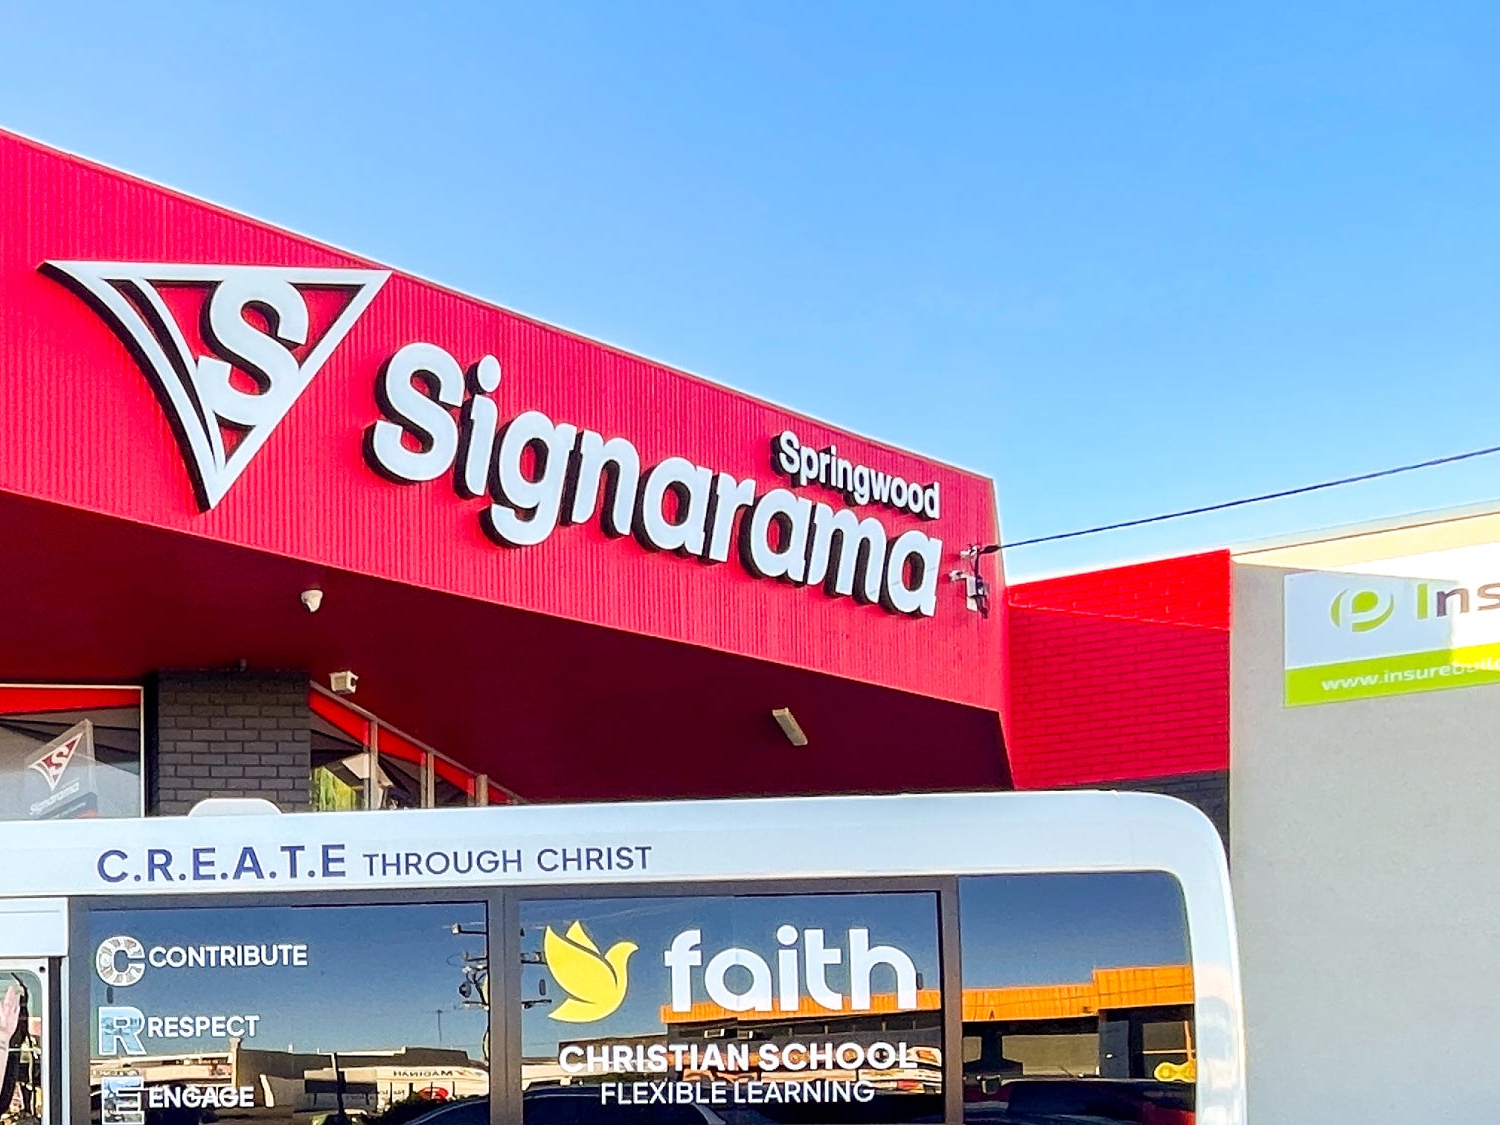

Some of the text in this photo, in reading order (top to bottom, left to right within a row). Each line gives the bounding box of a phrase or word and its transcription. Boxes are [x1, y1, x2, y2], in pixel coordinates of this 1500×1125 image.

[370, 341, 943, 618] Signarama
[778, 430, 942, 520] Springwood
[96, 844, 653, 884] C.R.E.A.T.E THROUGH CHRIST
[148, 943, 309, 969] CONTRIBUTE
[664, 924, 918, 1013] faith
[147, 1015, 260, 1039] RESPECT
[558, 1041, 920, 1075] CHRISTIAN SCHOOL
[148, 1085, 256, 1110] ENGAGE
[600, 1079, 876, 1106] FLEXIBLE LEARNING
